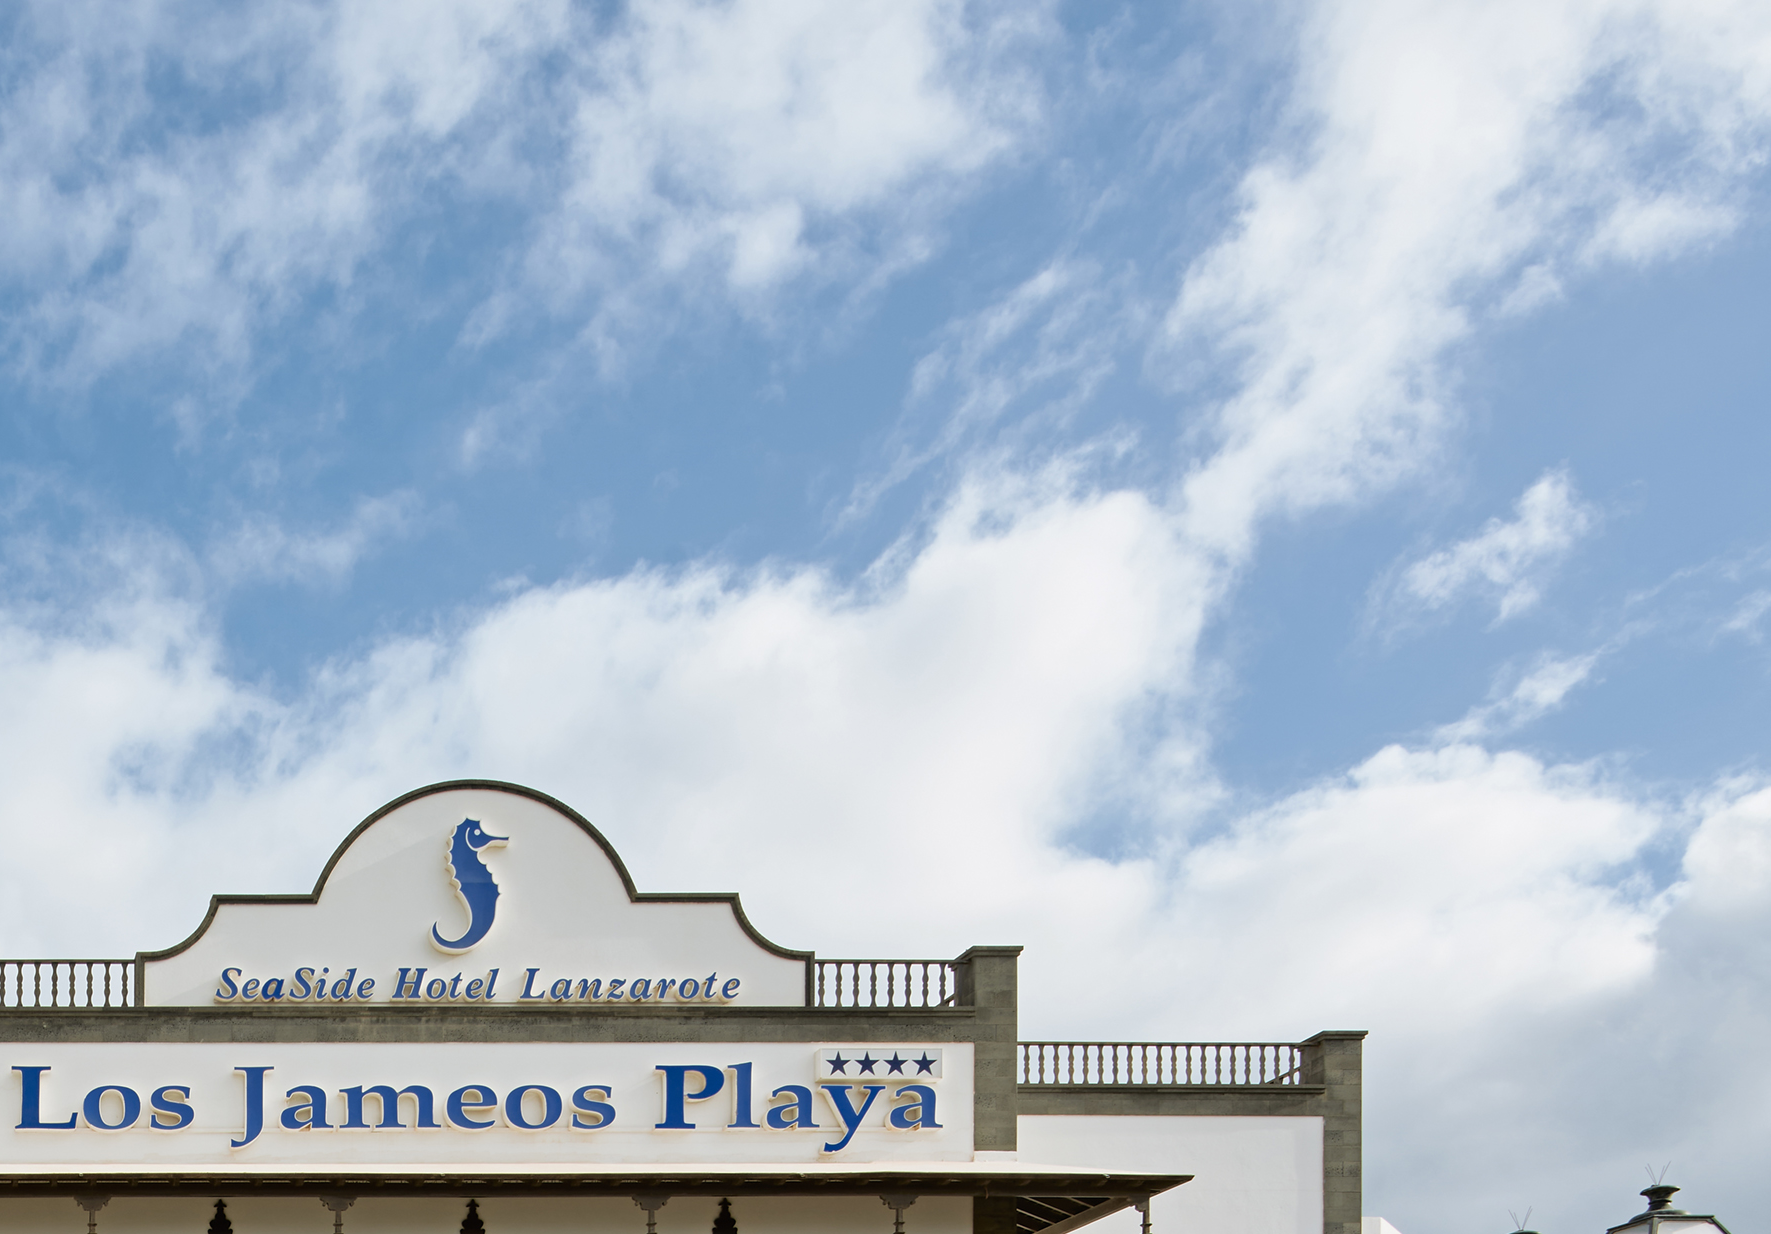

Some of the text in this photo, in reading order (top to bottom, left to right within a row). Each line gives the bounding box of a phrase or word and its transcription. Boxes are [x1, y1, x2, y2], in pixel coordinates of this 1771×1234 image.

[216, 966, 741, 1001] SeaSide Hotel Lanzarote
[10, 1061, 944, 1154] Los Jameos Playa
